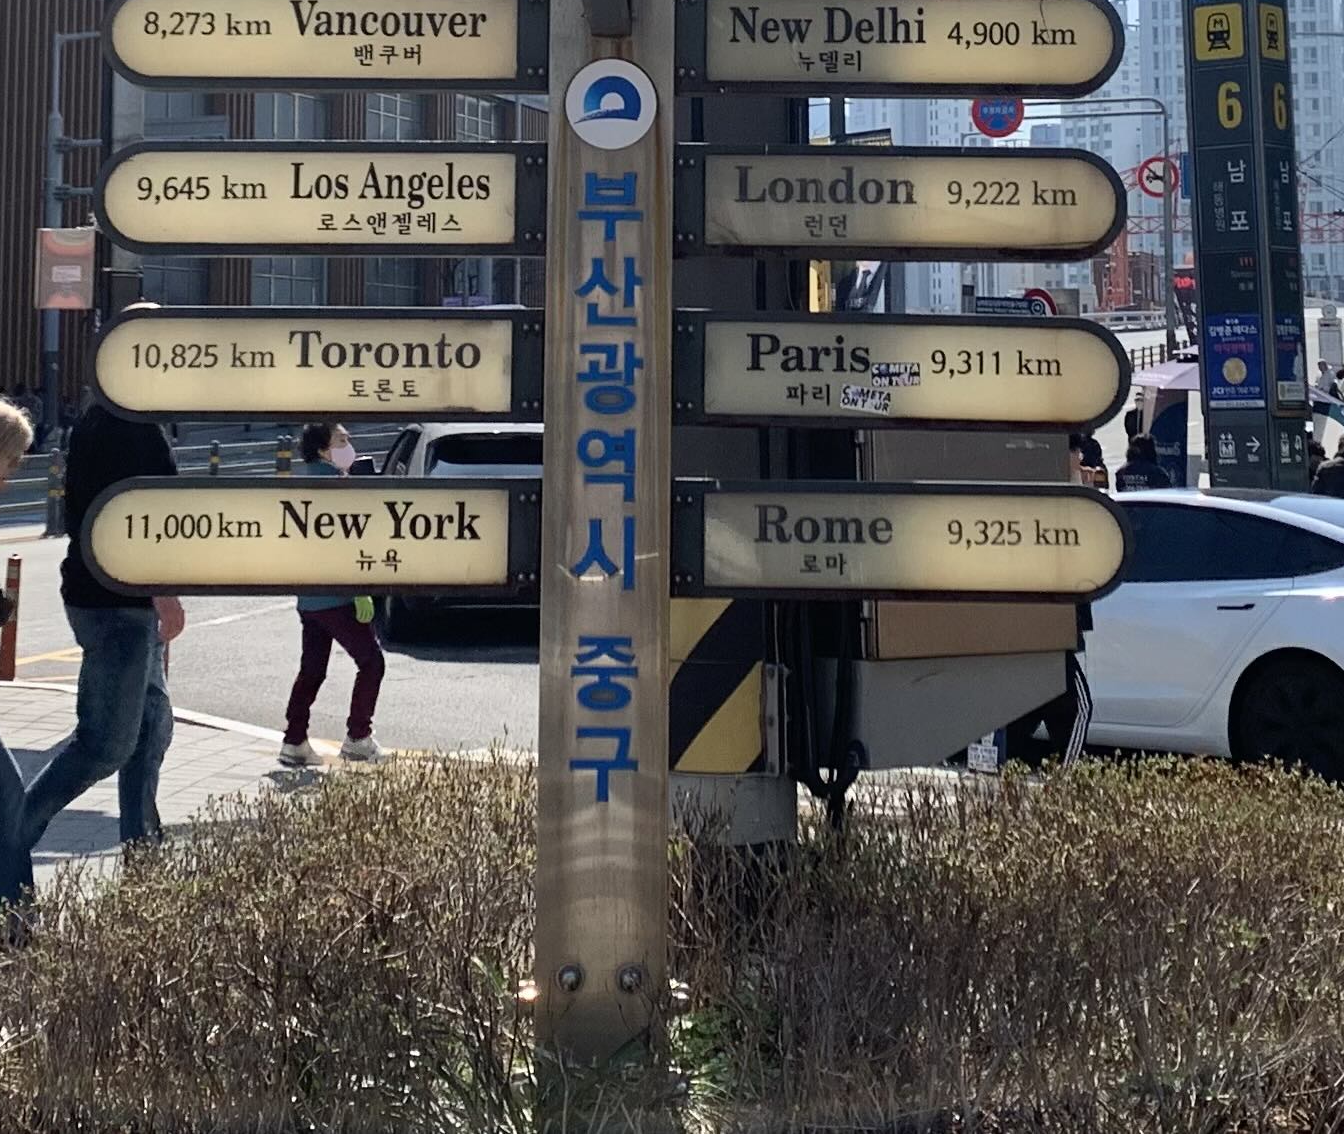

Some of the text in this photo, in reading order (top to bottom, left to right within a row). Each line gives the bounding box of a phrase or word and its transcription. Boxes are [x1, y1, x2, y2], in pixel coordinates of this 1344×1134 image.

[144, 0, 487, 39] 8,273 km Vancouver
[729, 6, 1077, 50] New Delhi 4,900 km
[354, 43, 422, 66] 밴쿠버
[1218, 81, 1242, 130] 6
[1273, 82, 1287, 130] 6
[137, 162, 491, 208] 9,645 km Los Angeles
[735, 166, 1078, 209] London 9,222 km
[1227, 159, 1250, 232] 남포
[317, 212, 462, 234] 로스앤젤레스
[804, 214, 848, 238] 런던
[132, 330, 482, 372] 10,825 km Toronto
[746, 333, 1063, 379] Paris 9,311 km
[348, 379, 421, 402] 토론토
[786, 383, 831, 407] 파리
[568, 170, 644, 804] 부산광역시 중구
[278, 500, 372, 539] New
[383, 501, 481, 540] York
[754, 504, 1080, 551] Rome 9,325 km
[356, 549, 403, 572] 뉴욕
[800, 553, 847, 577] 로마
